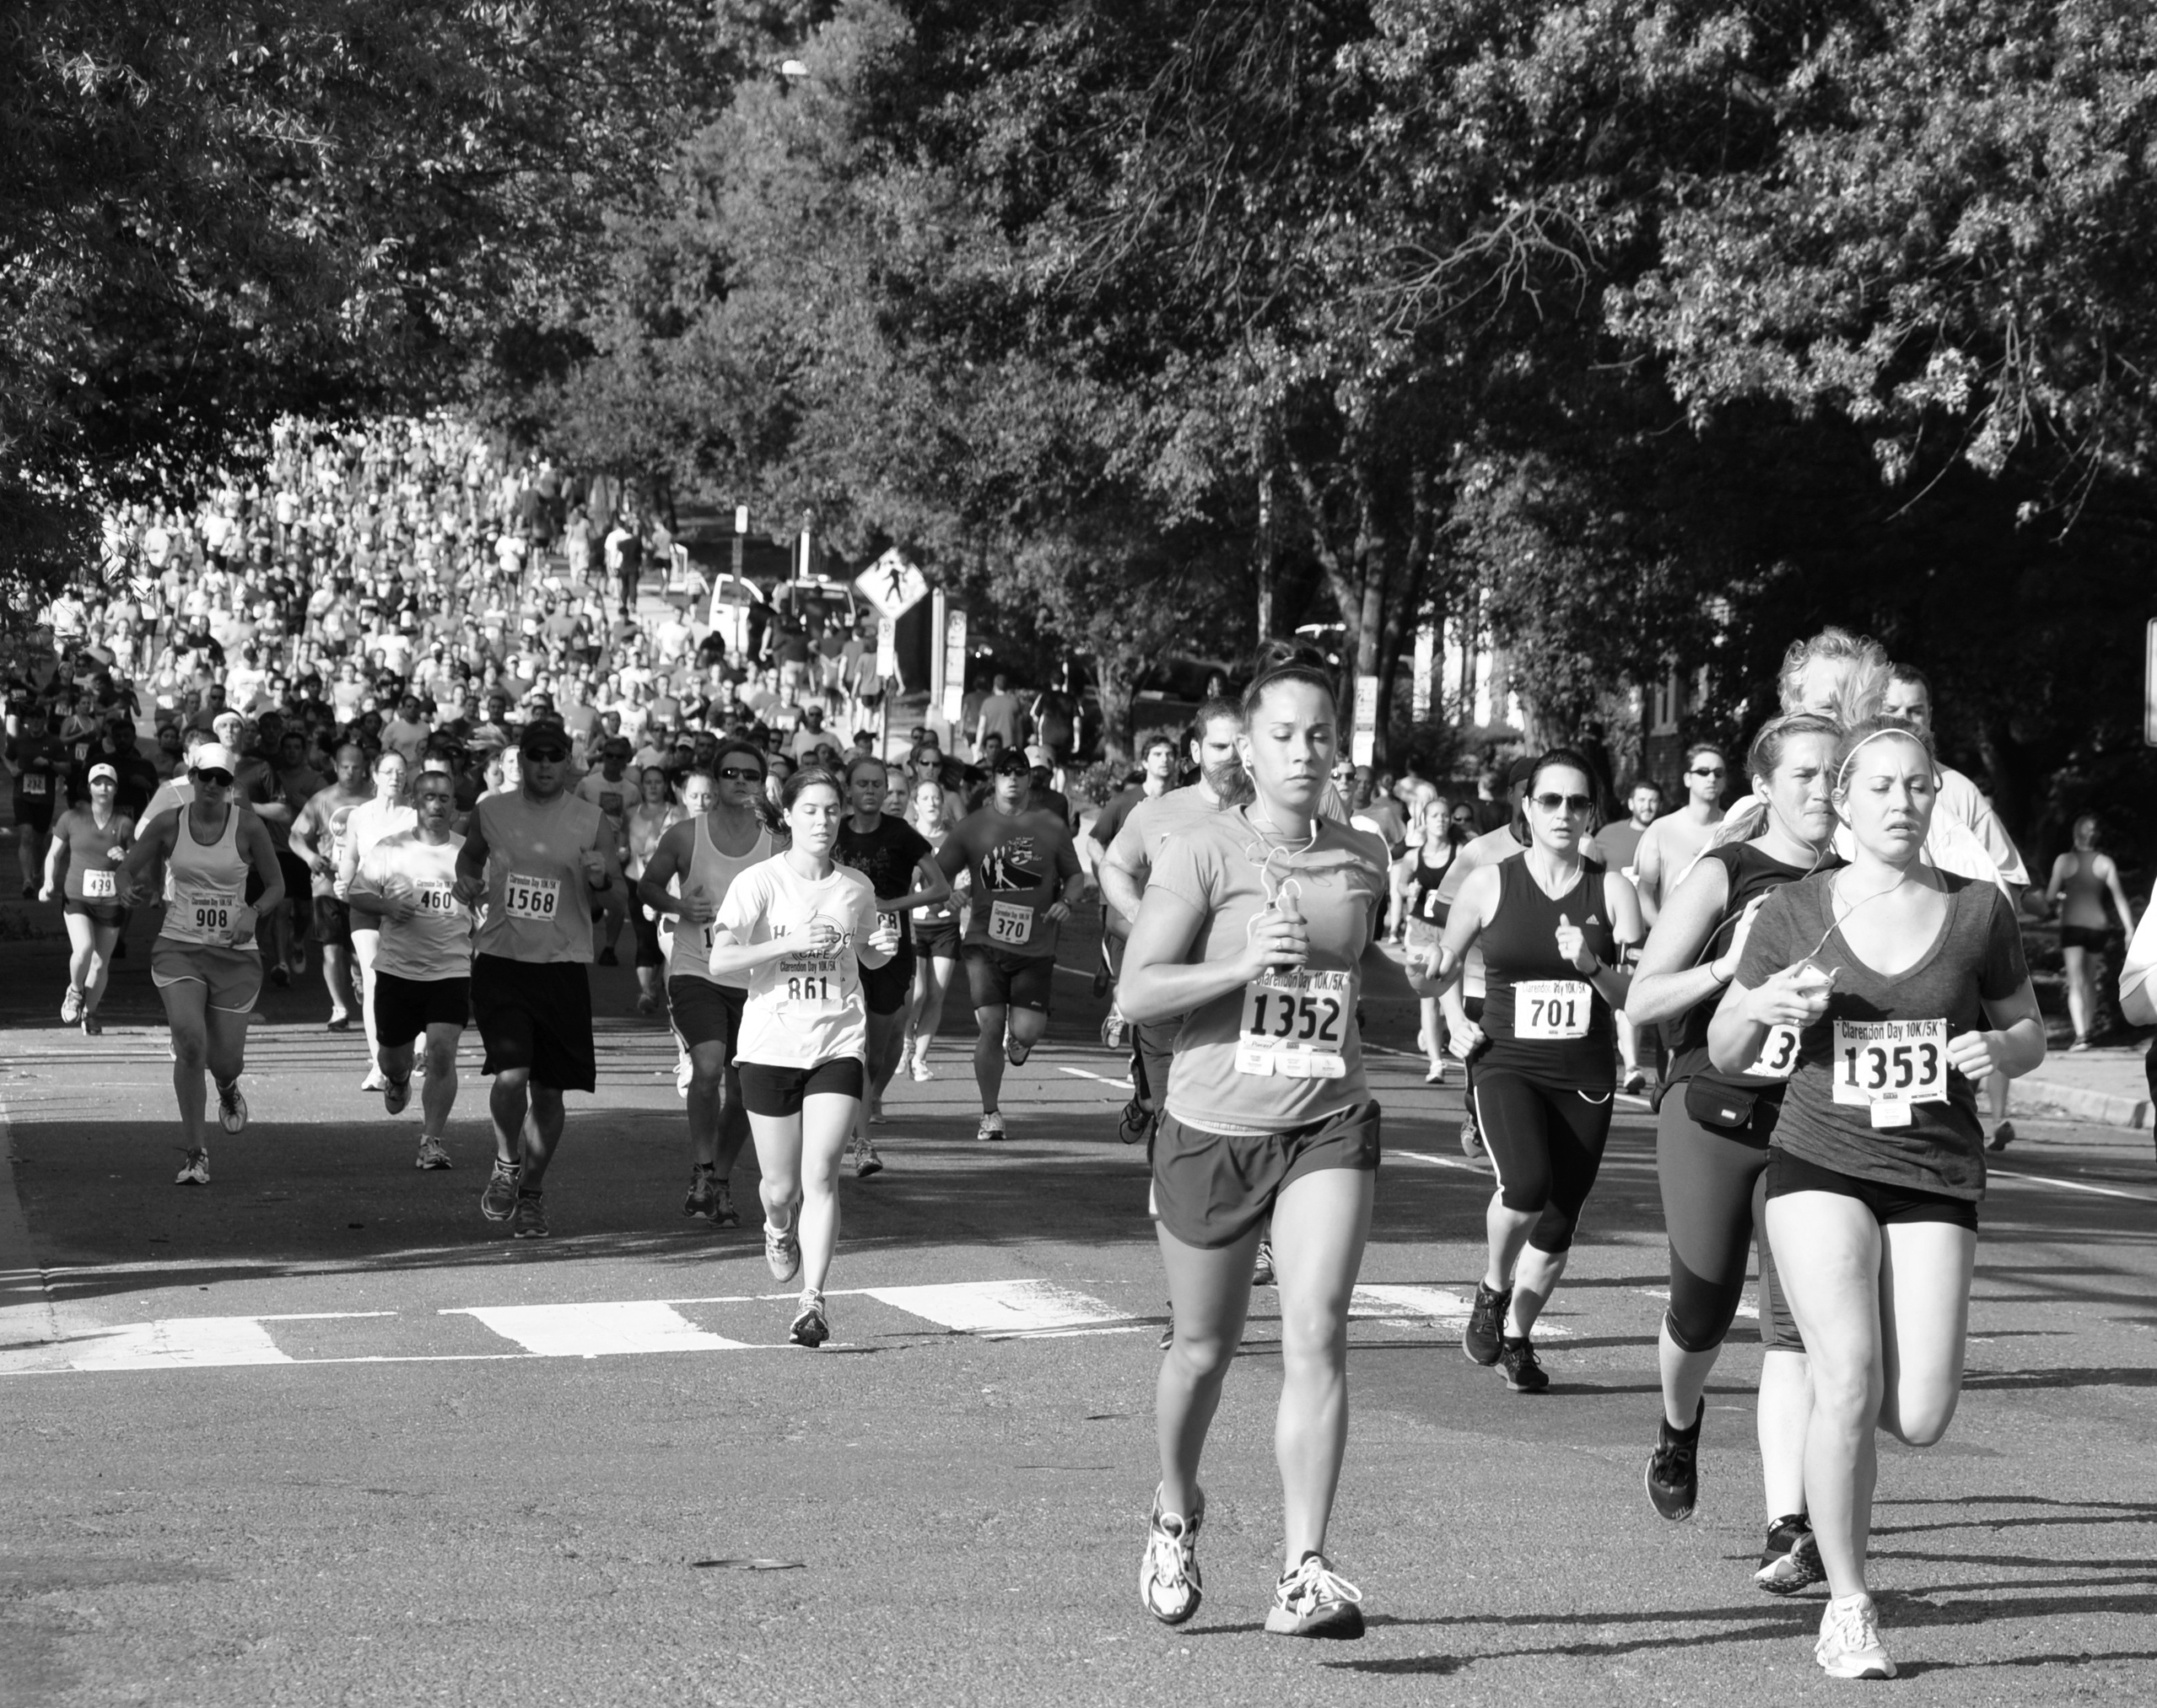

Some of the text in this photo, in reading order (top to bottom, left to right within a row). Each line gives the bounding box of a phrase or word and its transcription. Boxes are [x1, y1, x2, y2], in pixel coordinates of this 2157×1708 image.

[90, 879, 111, 892] 439
[420, 891, 452, 909] 460
[506, 887, 554, 914] 1568
[196, 908, 227, 929] 908
[996, 918, 1025, 939] 370
[779, 961, 837, 974] Clarendon Day 10K/5K
[788, 976, 829, 1000] 861
[1298, 972, 1312, 993] Day
[1314, 972, 1345, 992] 10K/5K
[1553, 982, 1564, 996] Day
[1250, 993, 1340, 1041] 1352
[1531, 999, 1576, 1027] 701
[1842, 1021, 1939, 1042] Clarendon Day 10K/5K
[1844, 1042, 1938, 1090] 1353
